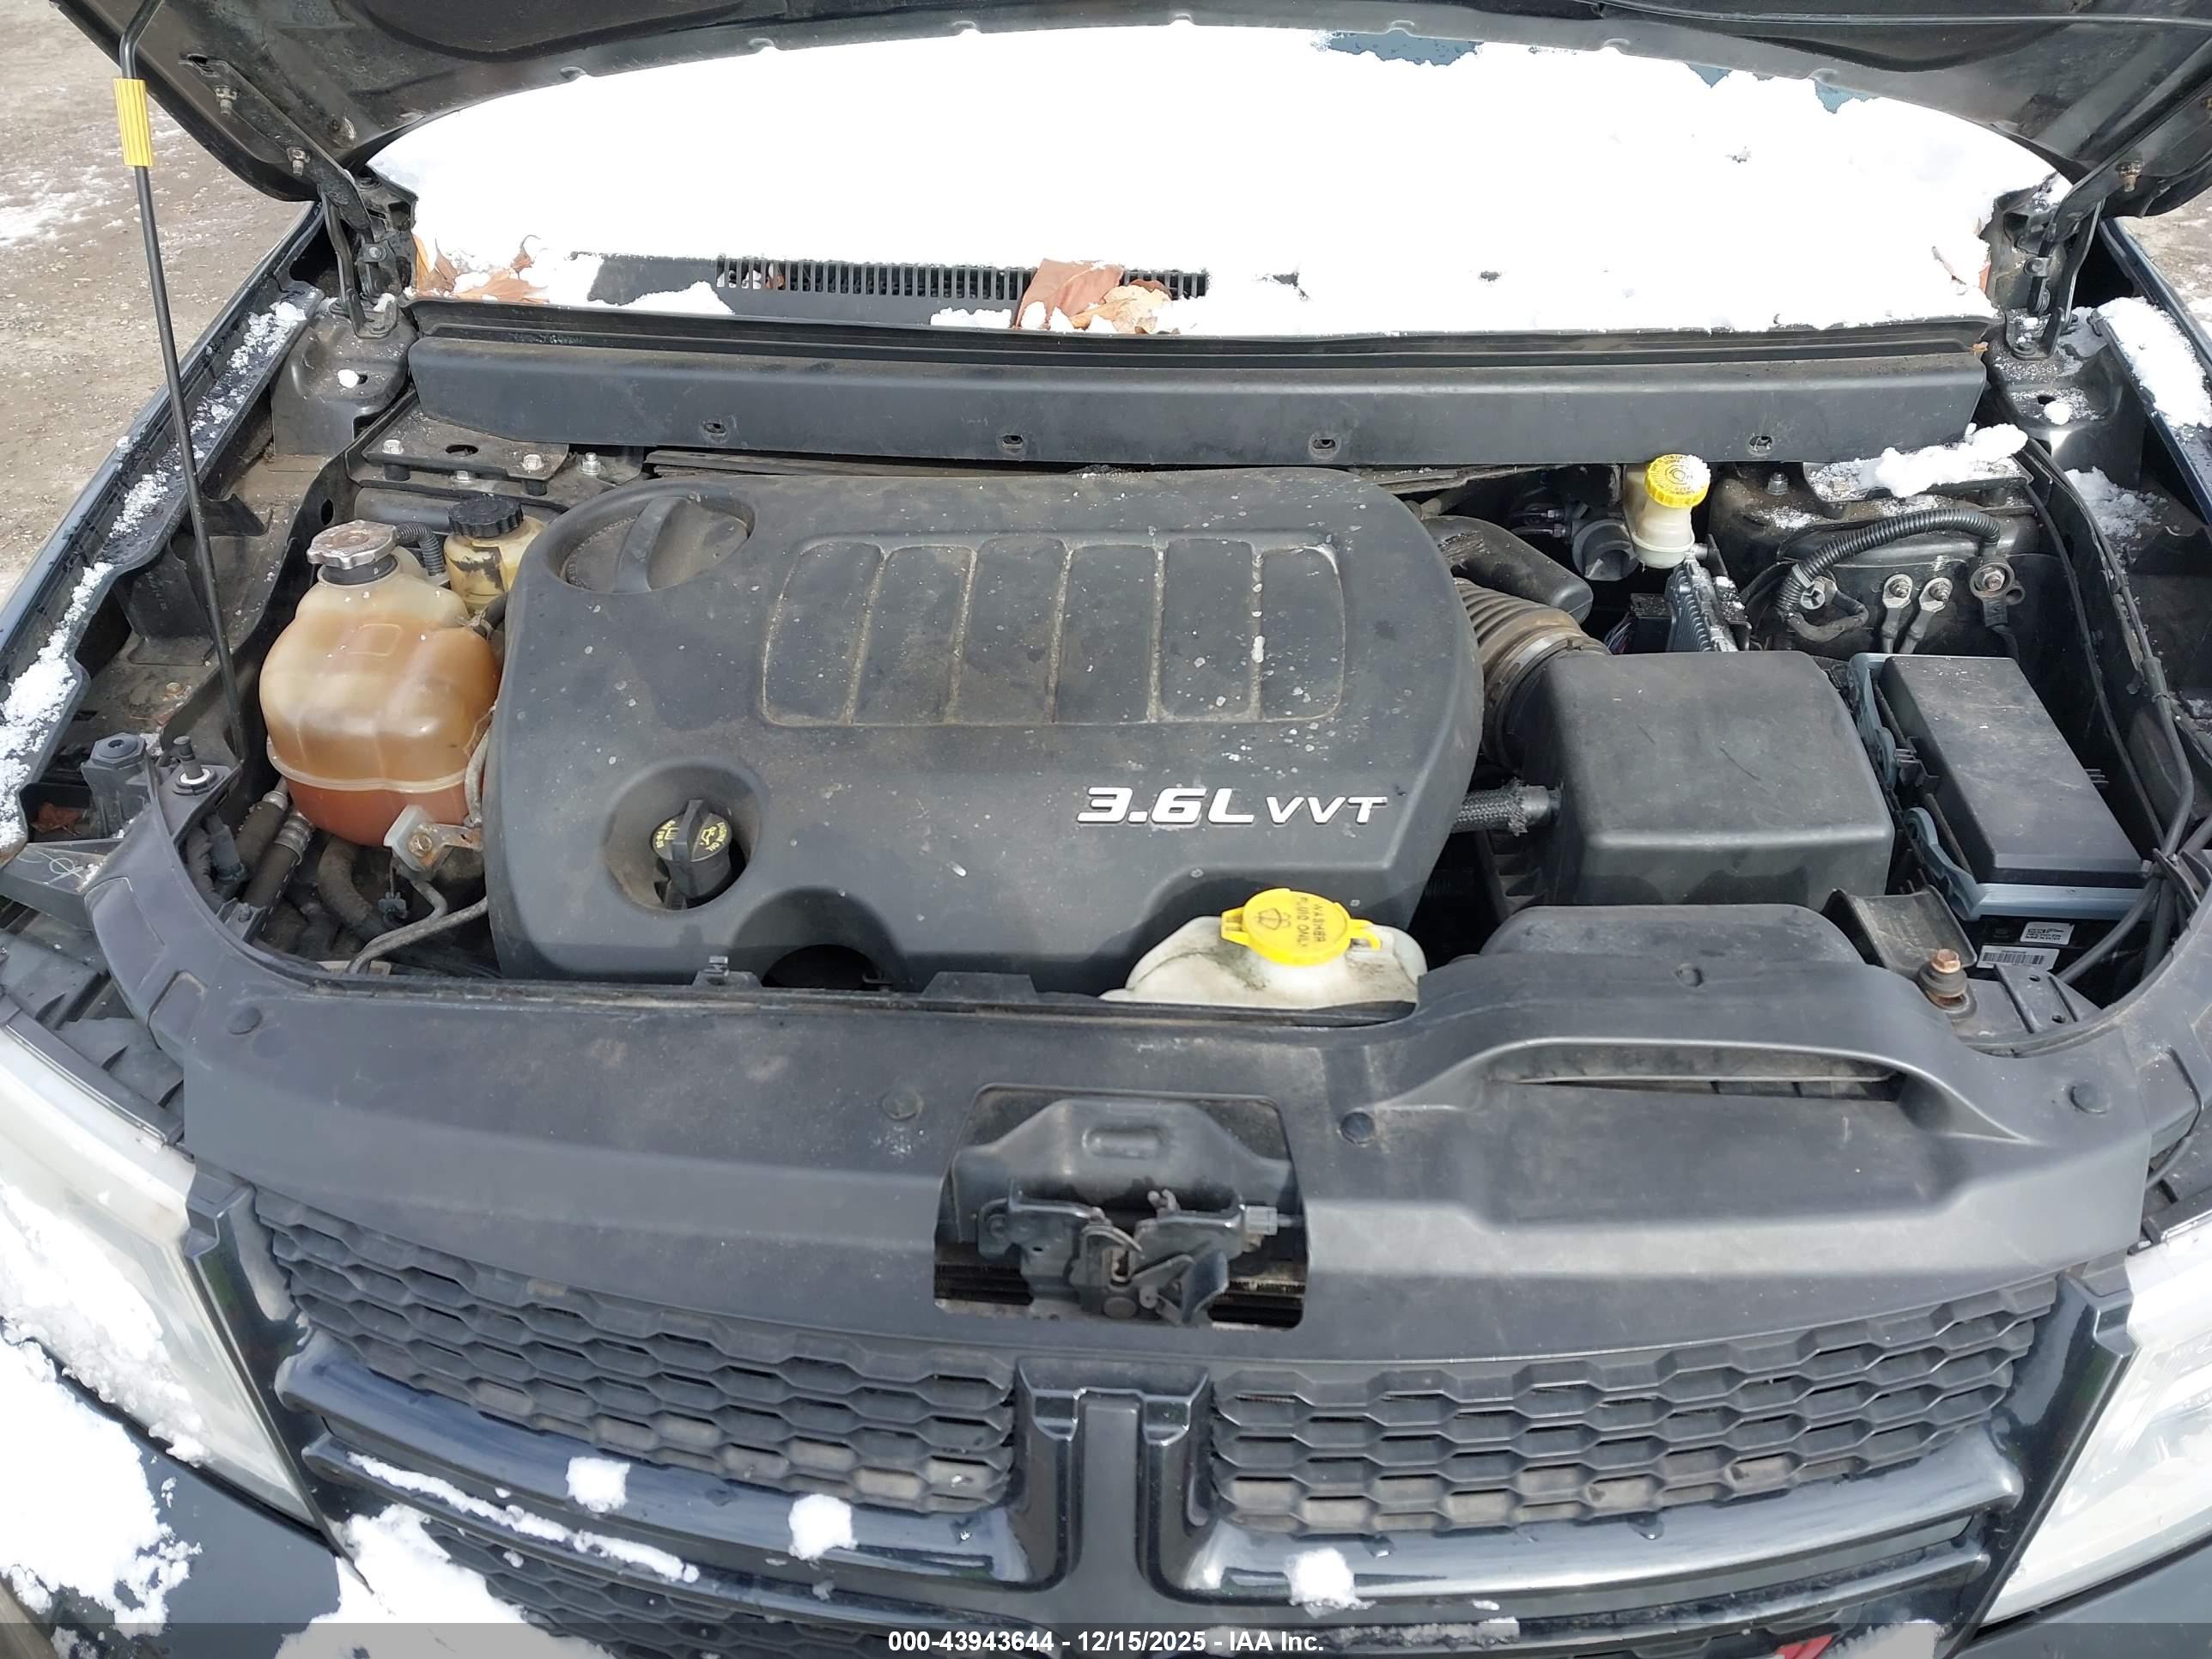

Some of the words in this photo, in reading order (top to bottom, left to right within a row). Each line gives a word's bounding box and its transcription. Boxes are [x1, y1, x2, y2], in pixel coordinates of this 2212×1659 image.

[1077, 786, 1255, 826] 3.6L
[1267, 796, 1388, 825] VVT
[1312, 903, 1326, 942] WASHER
